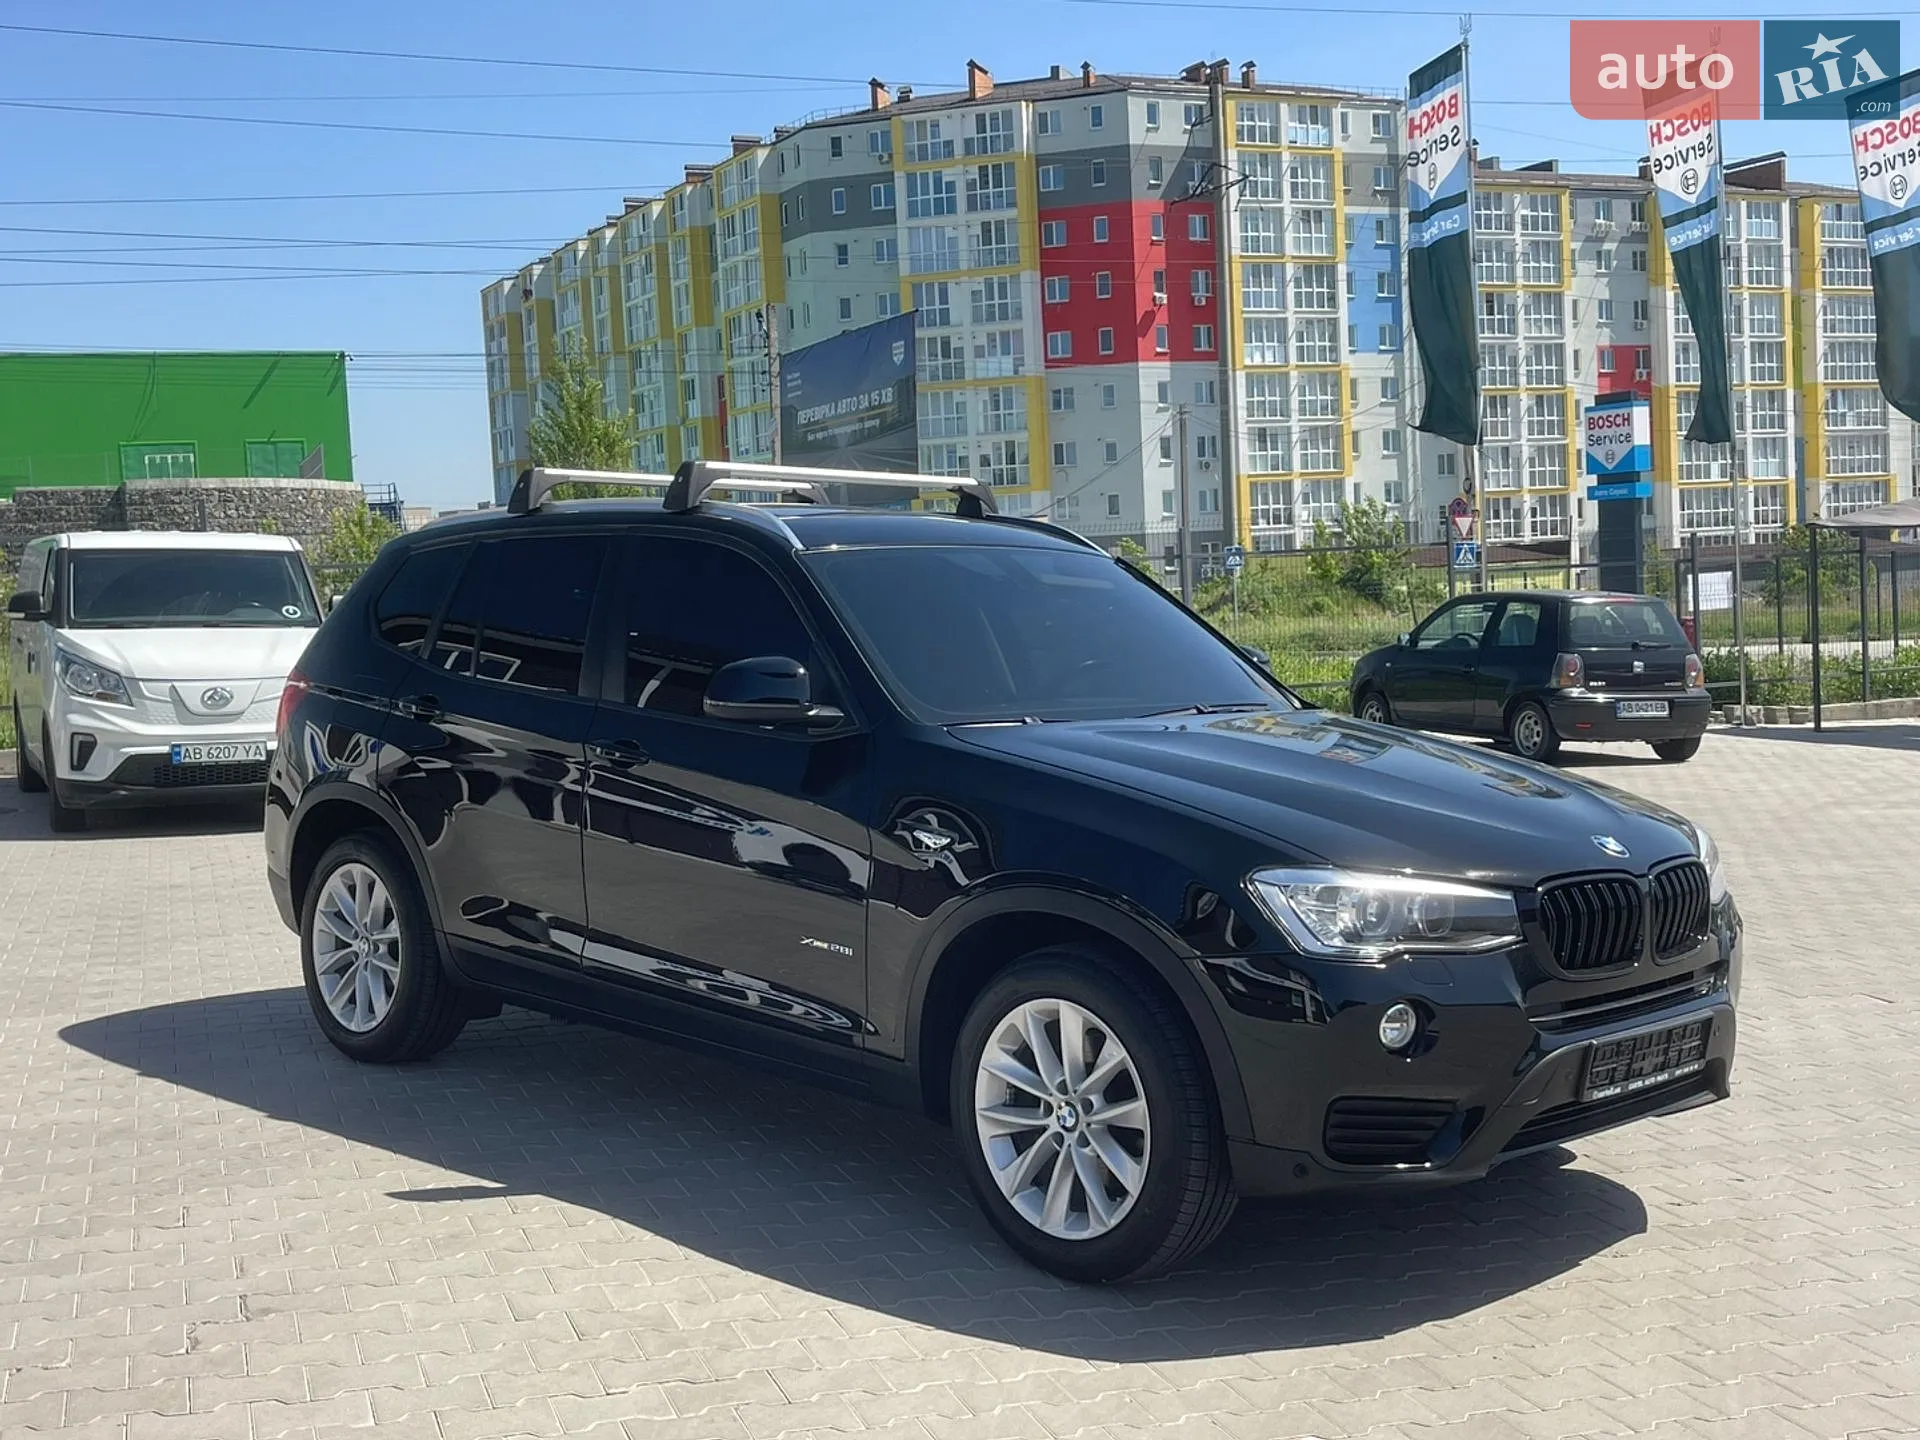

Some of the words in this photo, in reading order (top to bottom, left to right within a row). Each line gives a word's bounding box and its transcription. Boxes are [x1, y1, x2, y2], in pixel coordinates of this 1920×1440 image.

[1588, 412, 1631, 430] BOSCH
[1588, 430, 1632, 447] Service
[182, 747, 203, 760] AB
[206, 746, 239, 760] 6207
[243, 745, 263, 758] YA
